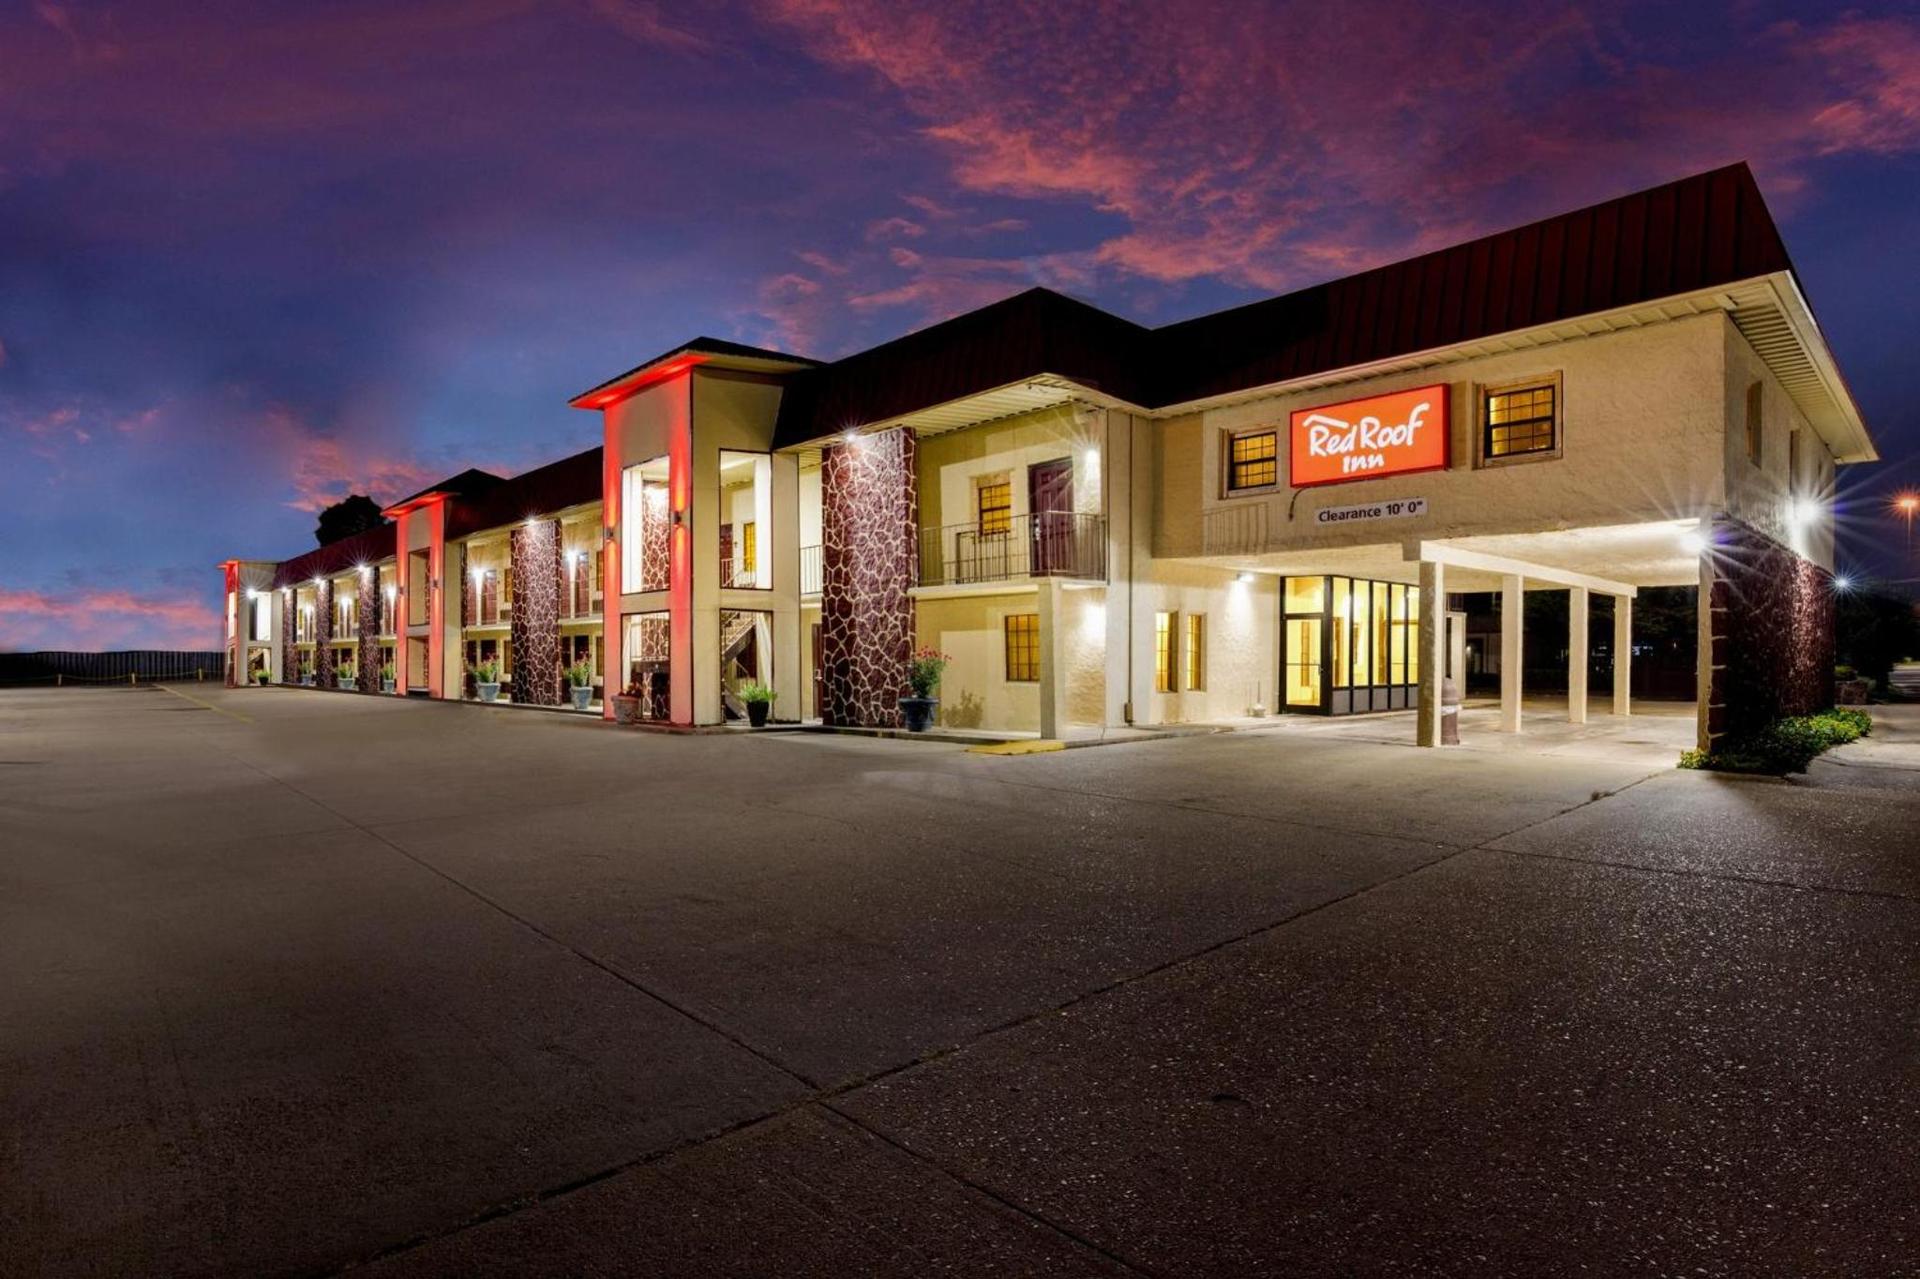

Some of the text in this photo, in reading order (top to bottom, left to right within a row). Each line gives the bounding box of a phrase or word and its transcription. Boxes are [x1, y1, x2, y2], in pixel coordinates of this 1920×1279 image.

[1310, 402, 1430, 457] Red Roof
[1318, 507, 1381, 522] Clearance
